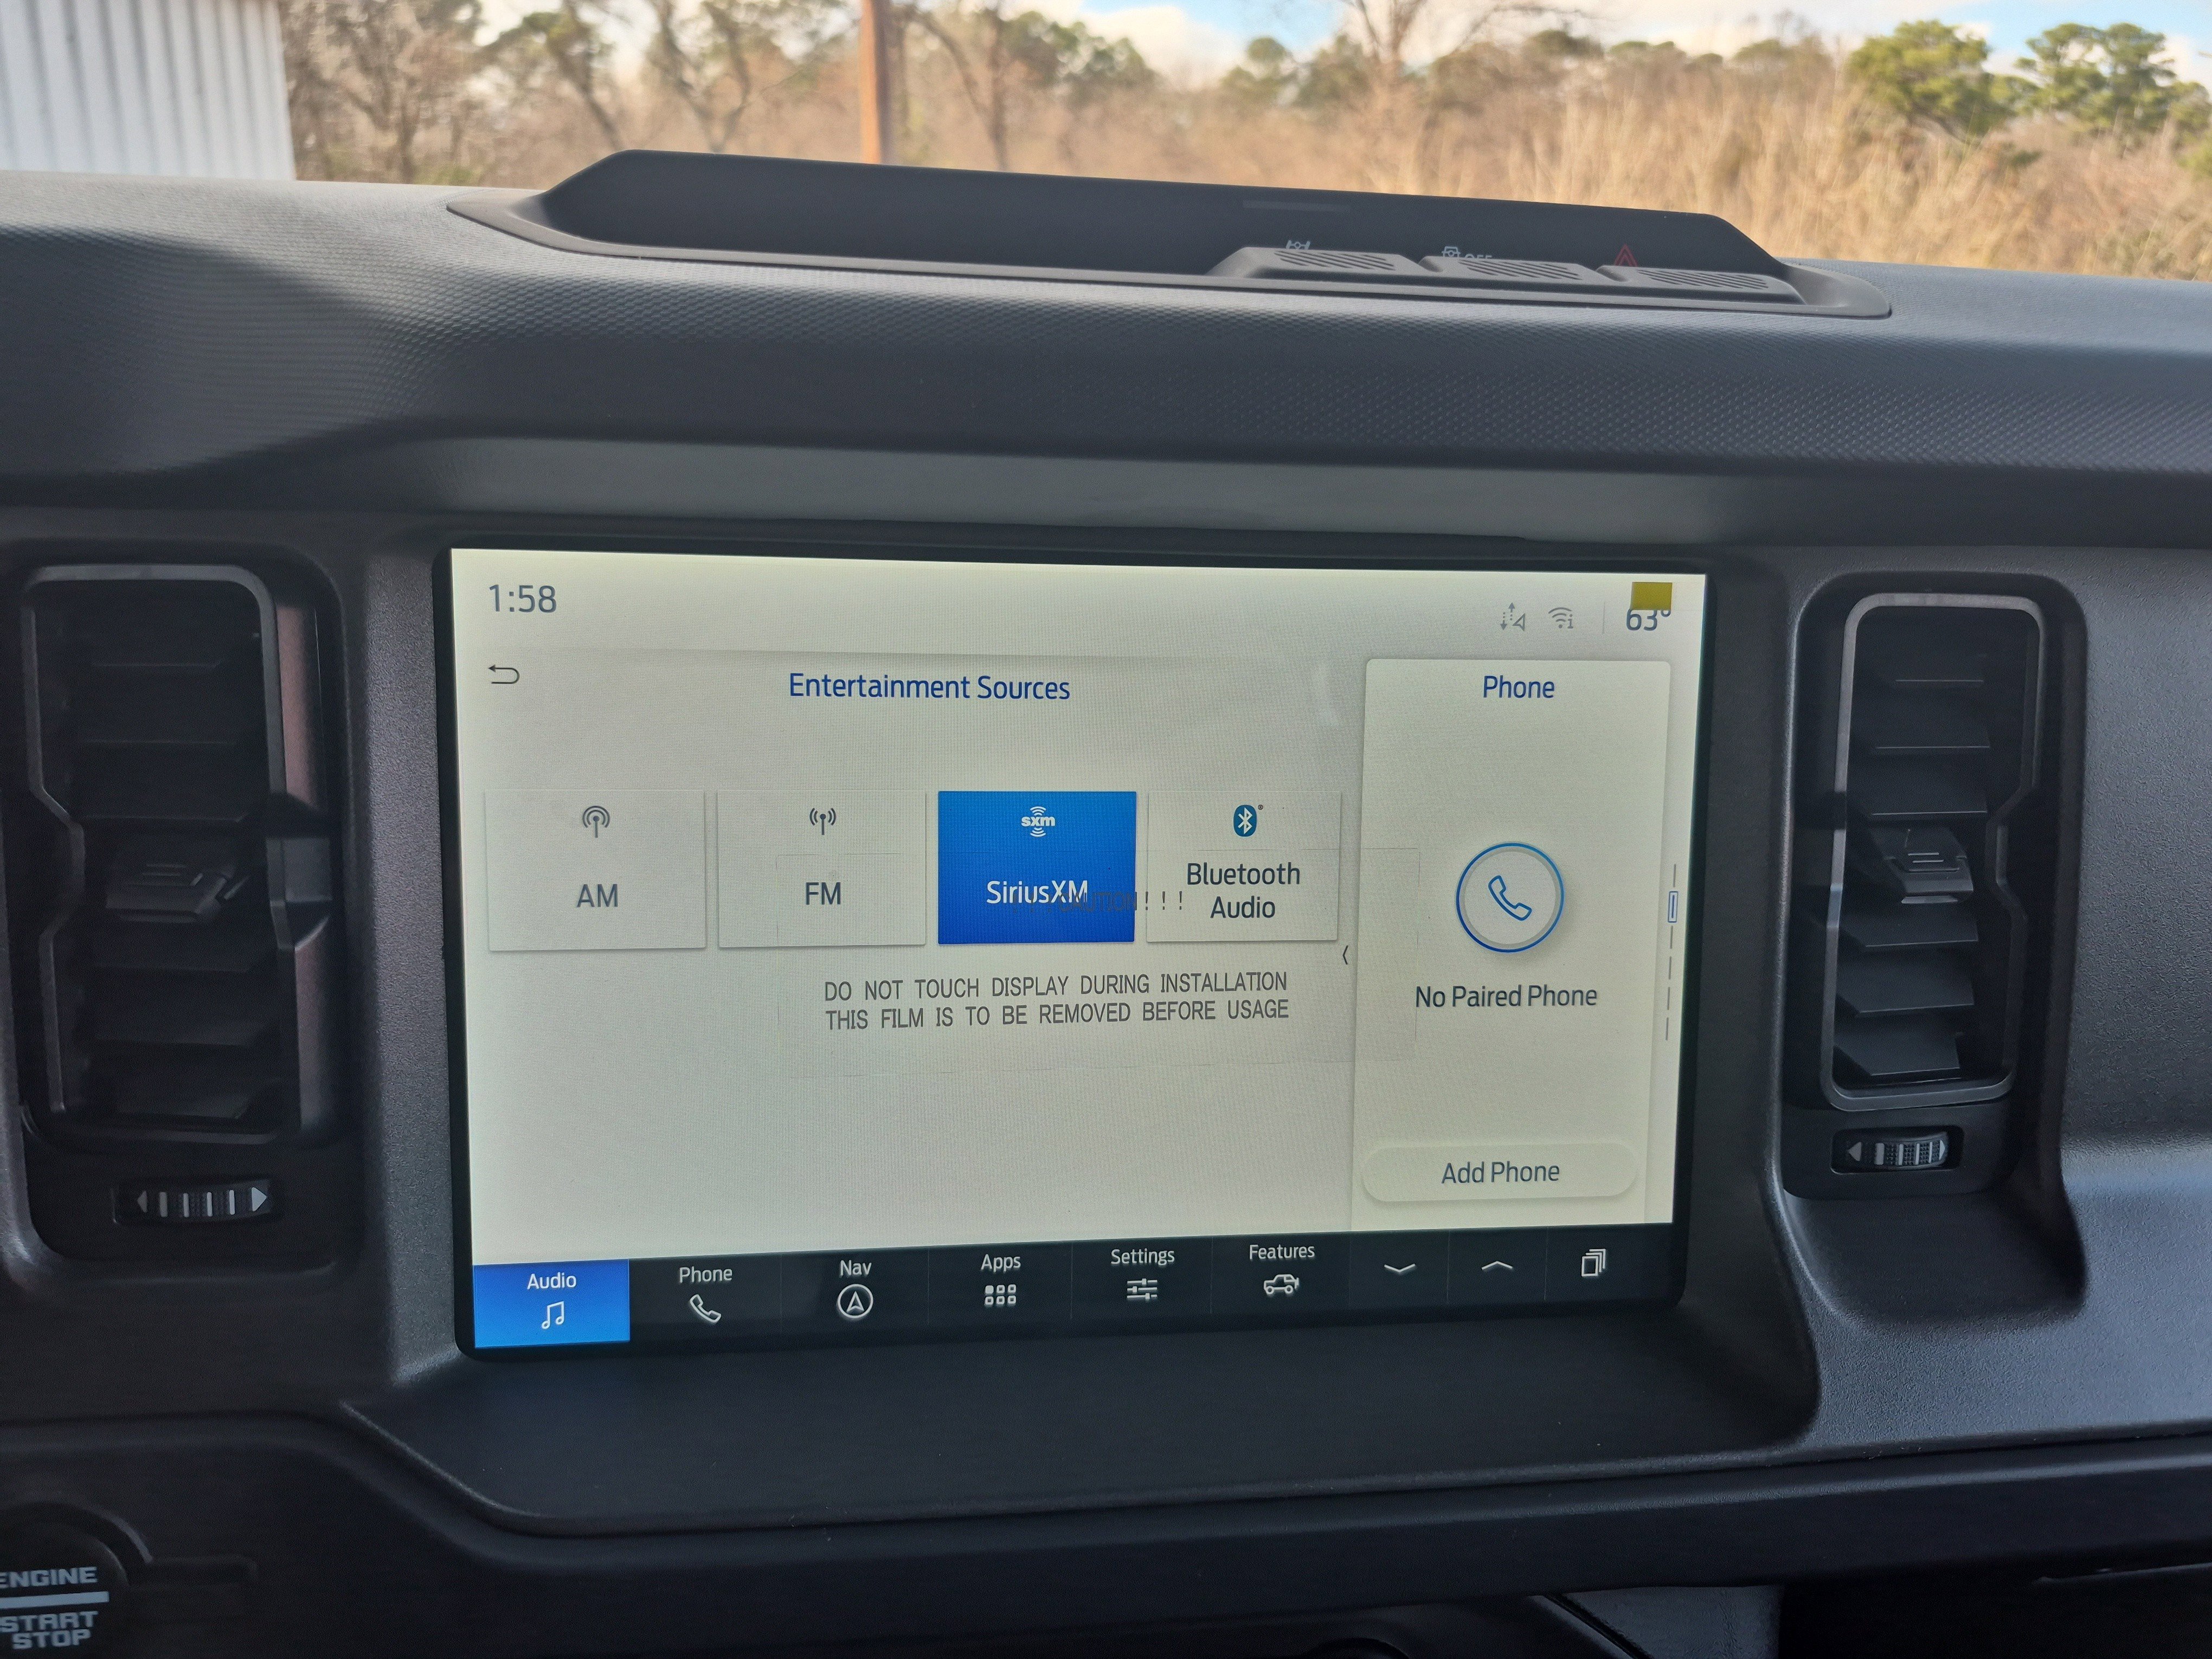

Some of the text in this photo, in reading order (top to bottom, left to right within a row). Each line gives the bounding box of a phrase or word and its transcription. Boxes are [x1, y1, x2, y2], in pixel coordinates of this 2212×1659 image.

[488, 584, 557, 613] 1:58
[790, 673, 1070, 700] Entertainment Sources
[1483, 674, 1555, 699] Phone
[1021, 816, 1056, 827] sxm
[1187, 861, 1301, 885] Bluetooth
[576, 883, 619, 908] AM
[805, 882, 841, 905] FM
[986, 879, 1088, 904] SiriusXM
[1210, 895, 1276, 918] Audio
[825, 971, 1288, 1001] DO NOT TOUCH DISPLAY DURING INSTALLATION
[1415, 983, 1598, 1008] No Paired Phone
[825, 998, 1290, 1031] THIS FILM IS TO BE REMOVED BEFORE USAGE
[1441, 1160, 1560, 1184] Add Phone
[980, 1253, 1022, 1273] Apps
[1110, 1248, 1175, 1265] Settings
[1249, 1244, 1316, 1261] Features
[679, 1265, 733, 1283] Phone
[839, 1259, 872, 1277] Nav
[526, 1271, 577, 1290] Audio
[0, 1611, 99, 1632] START
[12, 1629, 91, 1649] STOP
